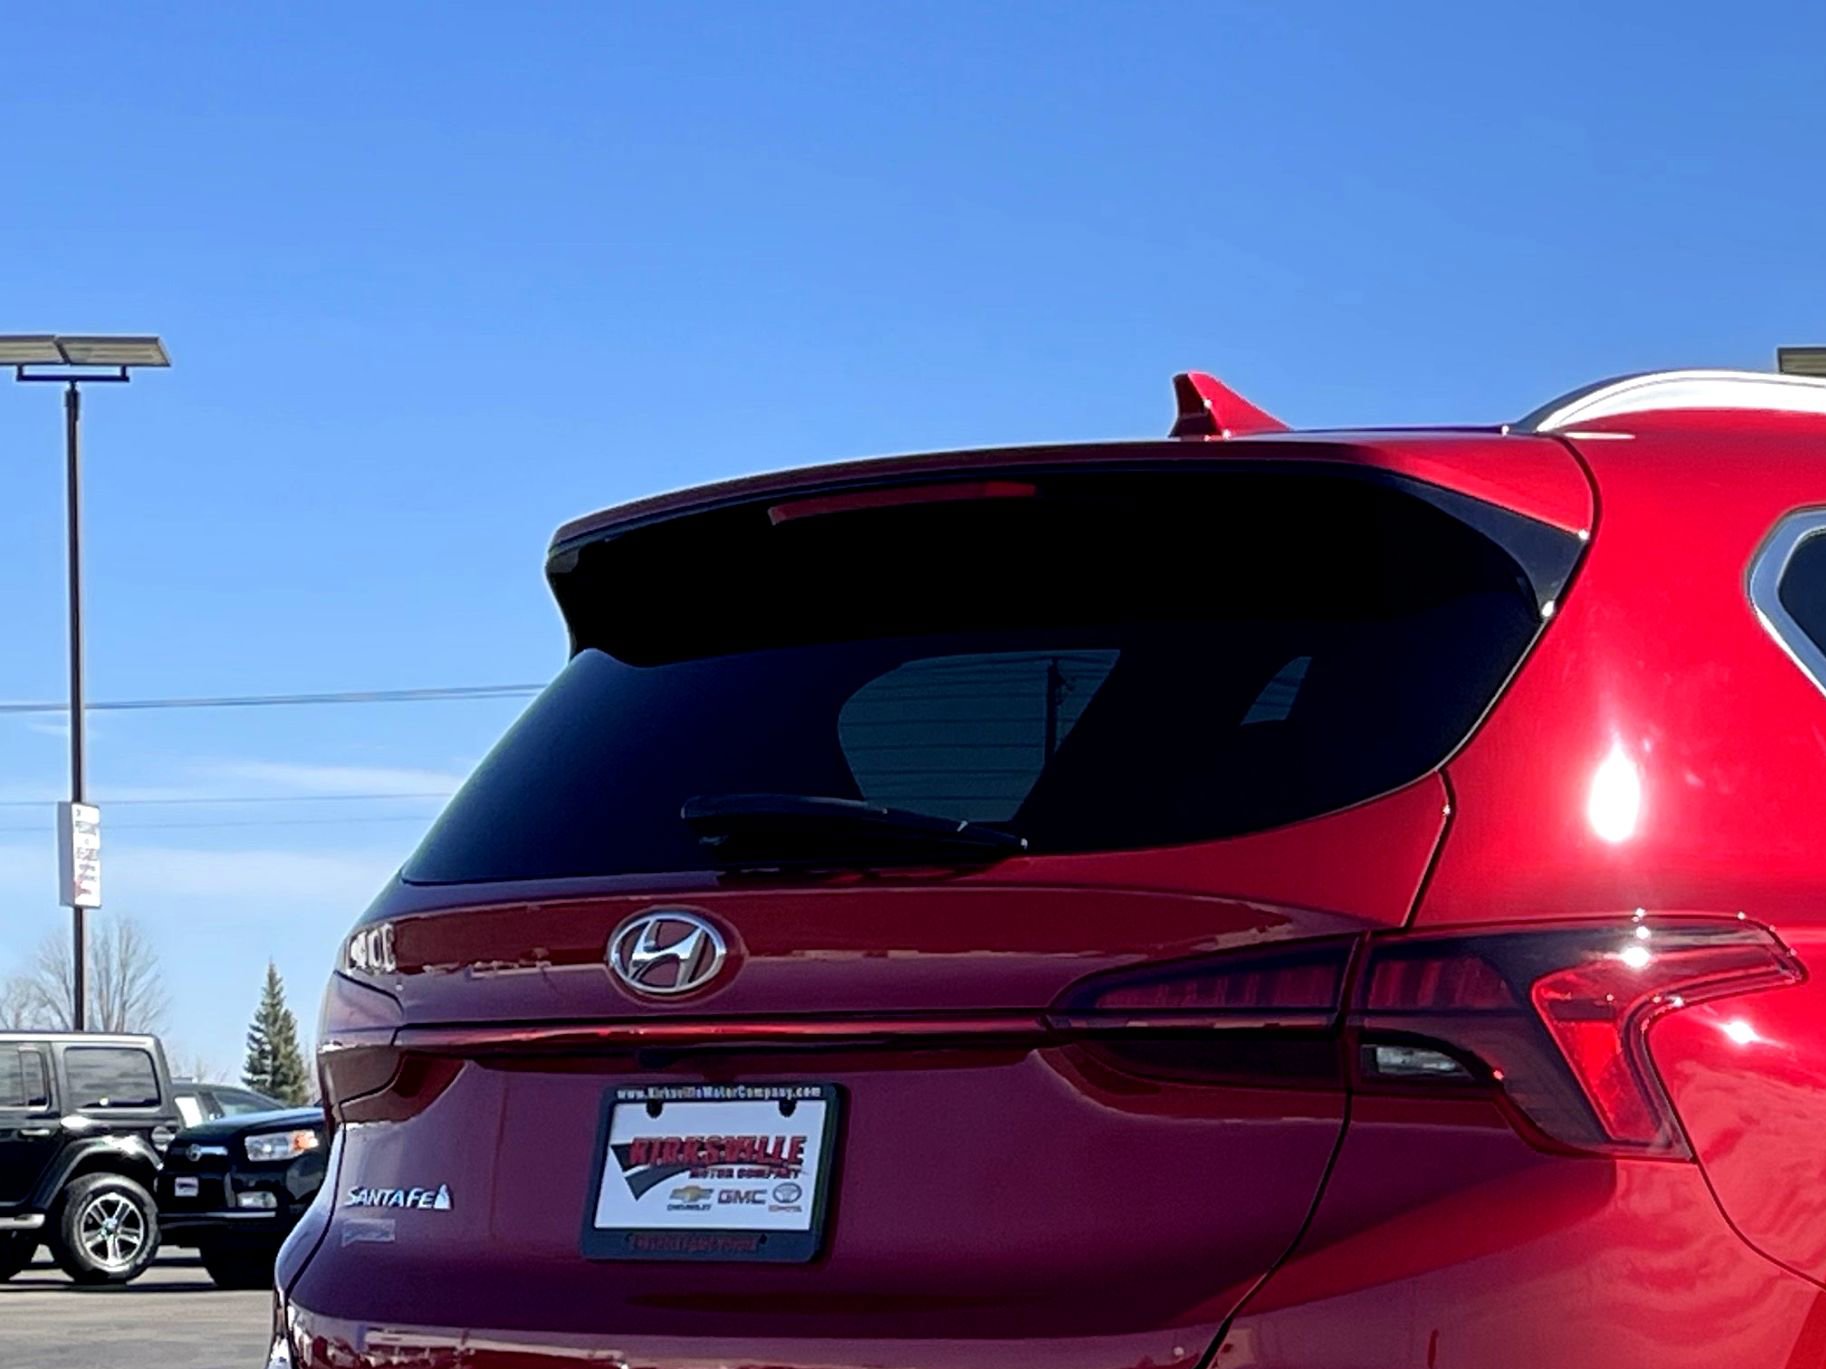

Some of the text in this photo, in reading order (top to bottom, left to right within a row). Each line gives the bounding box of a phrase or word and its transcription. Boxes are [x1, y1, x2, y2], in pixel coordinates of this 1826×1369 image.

[628, 1135, 807, 1166] KIRKSVILLE
[688, 1168, 735, 1180] MOTOR
[344, 1186, 434, 1208] SANTA FE
[717, 1189, 768, 1205] GMC
